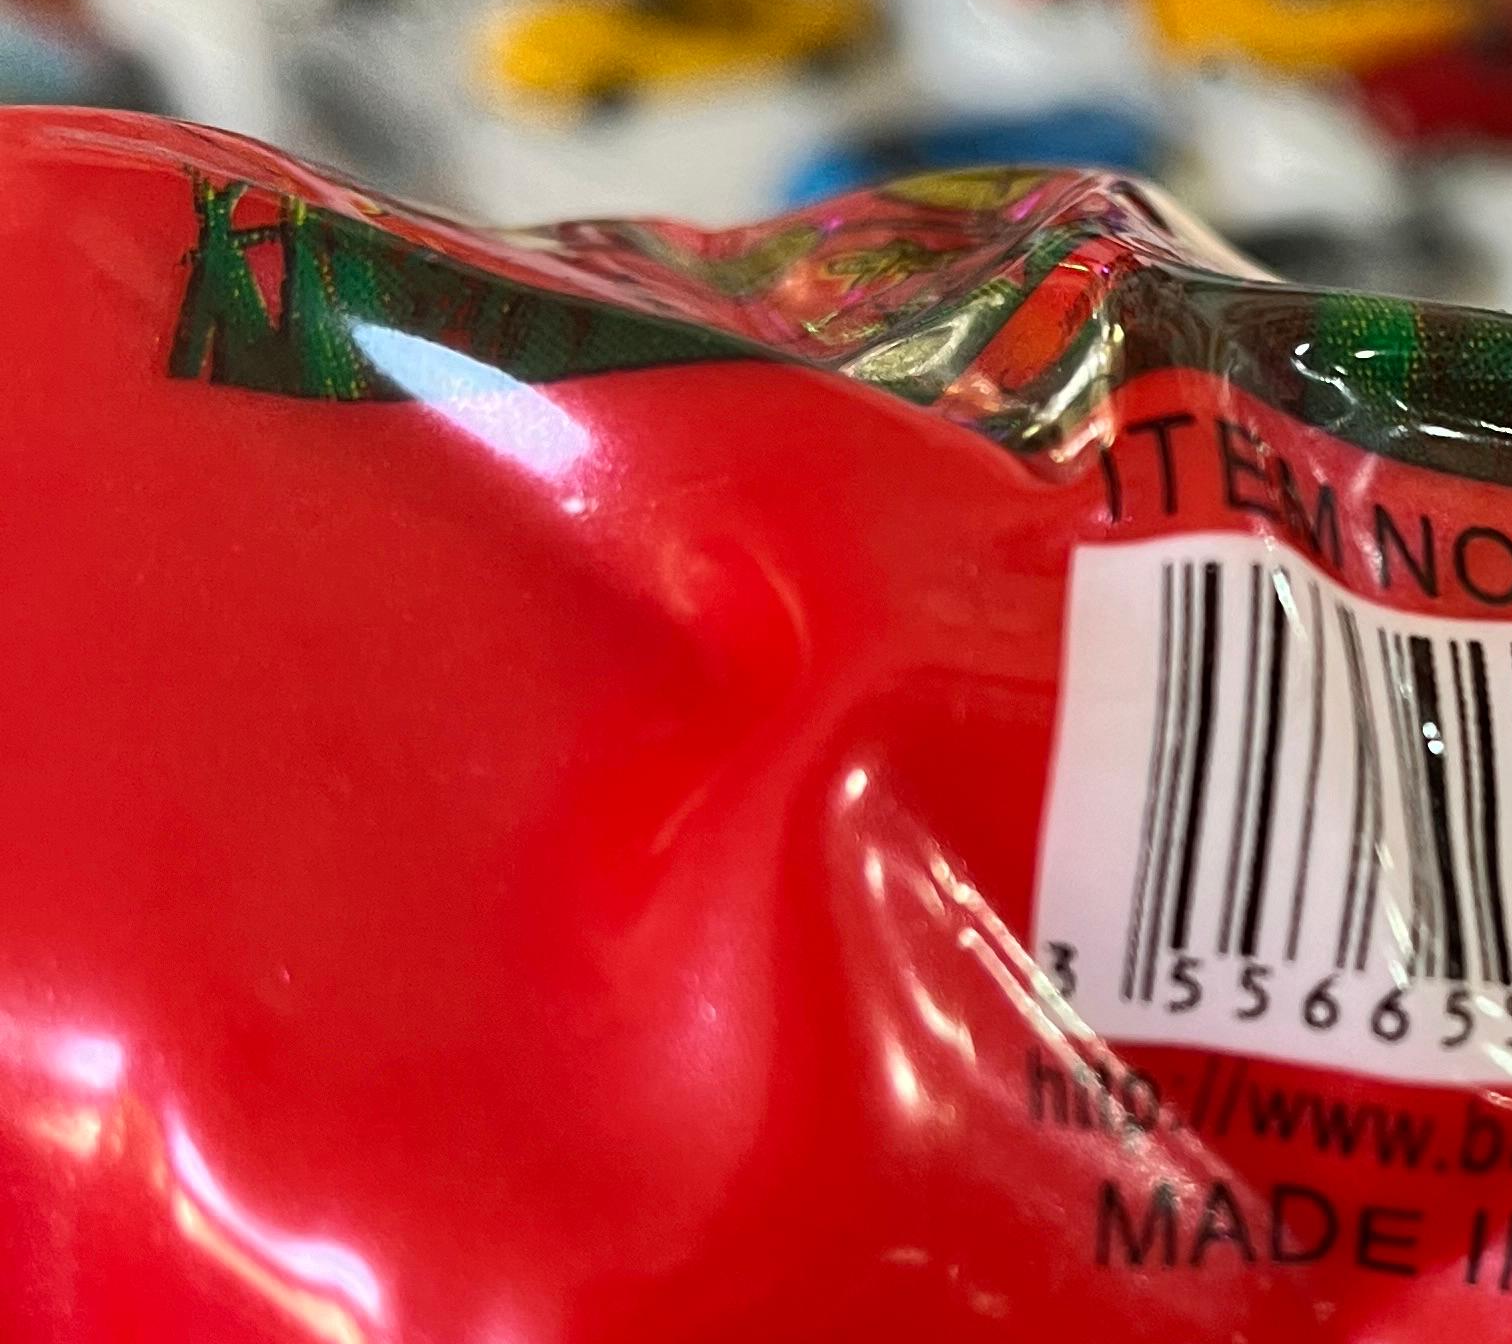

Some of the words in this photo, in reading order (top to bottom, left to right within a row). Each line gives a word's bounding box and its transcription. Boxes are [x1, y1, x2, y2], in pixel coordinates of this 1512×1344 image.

[1101, 412, 1343, 571] ITEM
[1047, 939, 1078, 1000] 3
[1096, 1180, 1424, 1277] MADE
